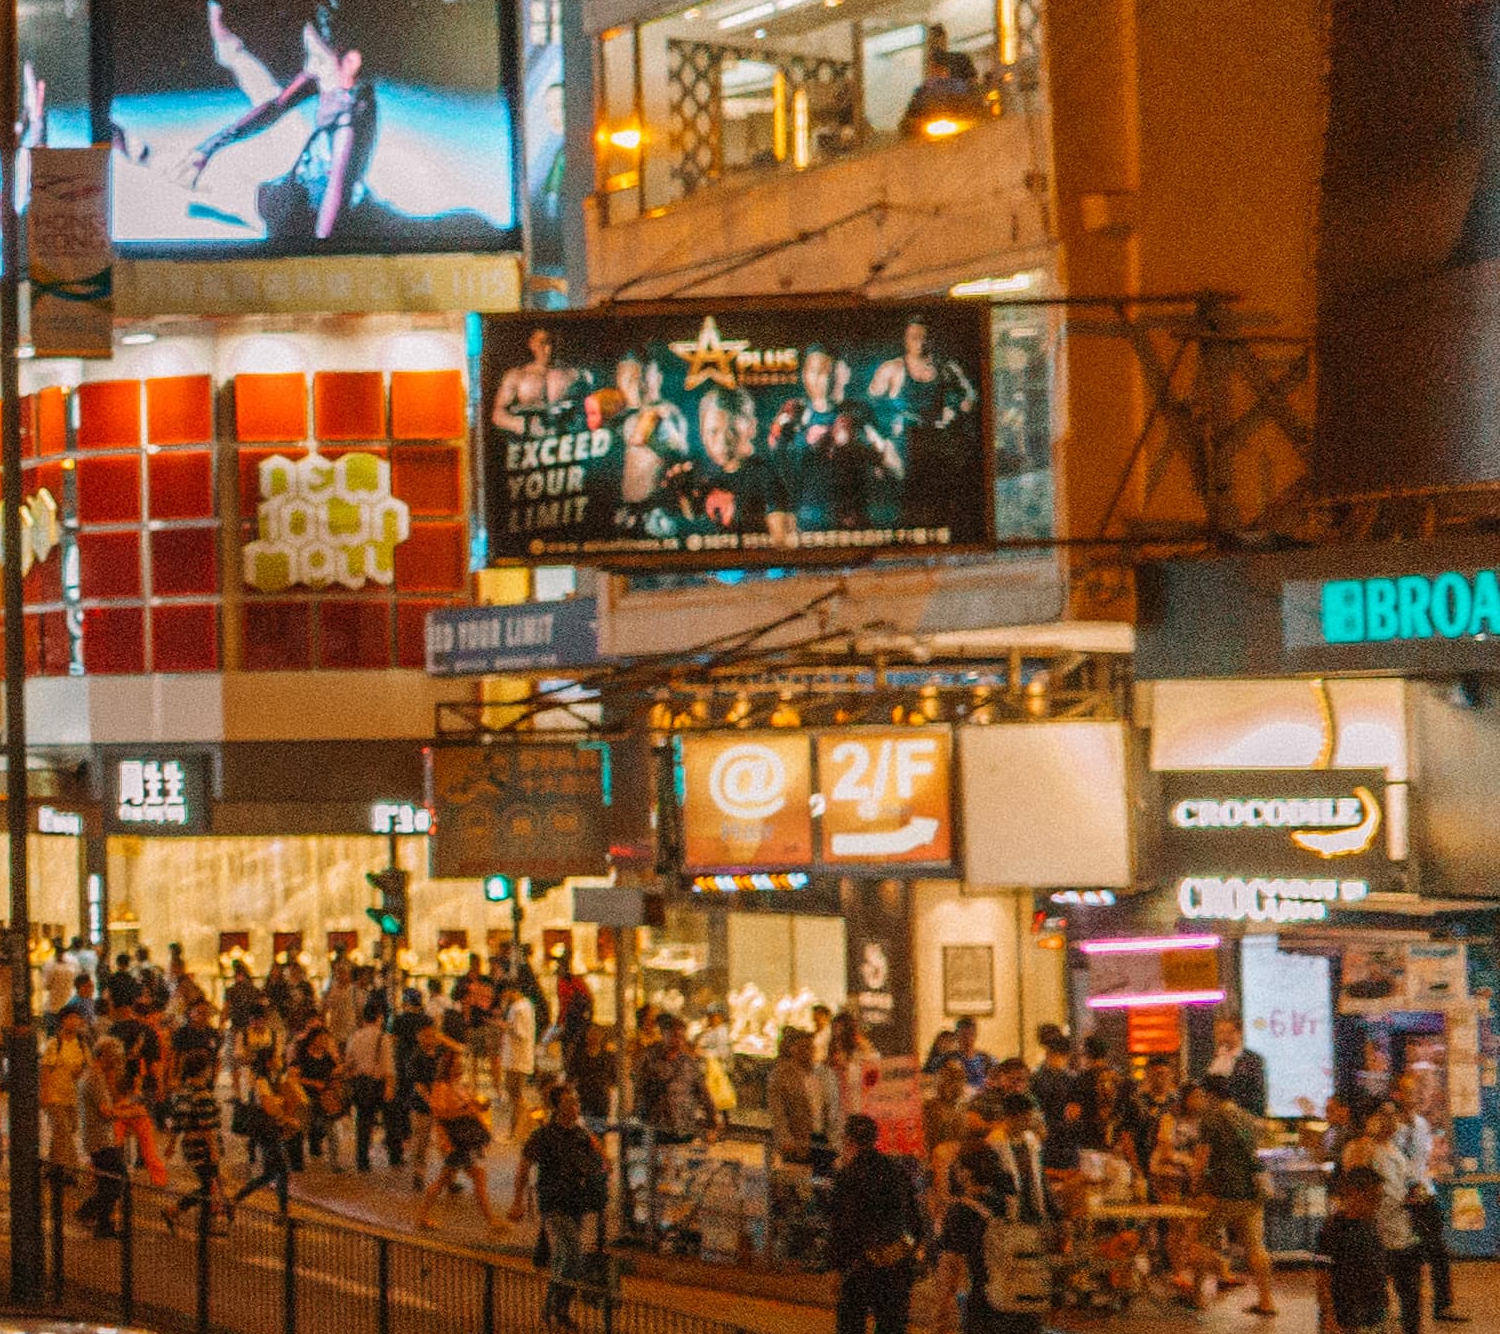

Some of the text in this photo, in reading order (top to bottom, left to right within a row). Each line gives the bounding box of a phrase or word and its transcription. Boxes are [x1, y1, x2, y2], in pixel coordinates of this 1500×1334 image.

[505, 429, 612, 471] EXCEED
[507, 466, 586, 502] YOUR
[508, 496, 590, 535] LIMIT
[830, 739, 936, 802] 2/F
[1176, 798, 1362, 827] CROCODILE
